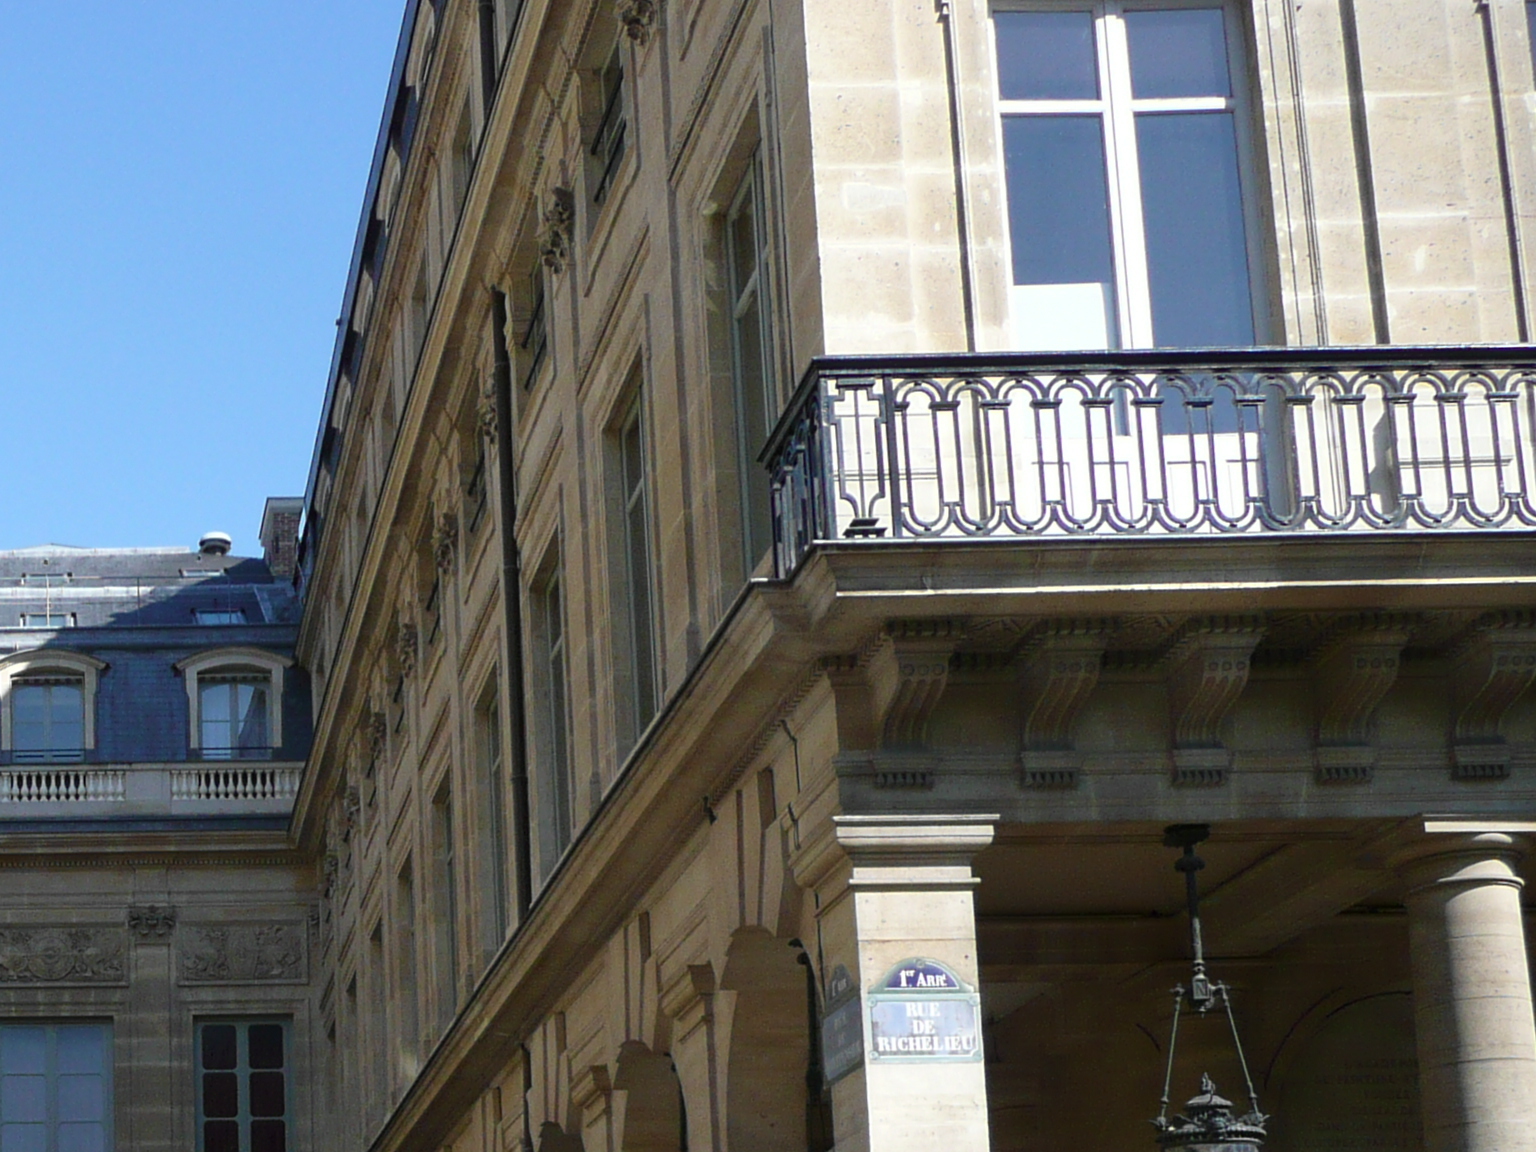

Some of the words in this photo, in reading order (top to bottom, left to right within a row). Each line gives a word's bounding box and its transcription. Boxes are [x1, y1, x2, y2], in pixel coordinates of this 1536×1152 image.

[906, 1001, 941, 1017] RUE
[913, 1019, 936, 1034] DE
[877, 1035, 974, 1052] RICHELIEU
